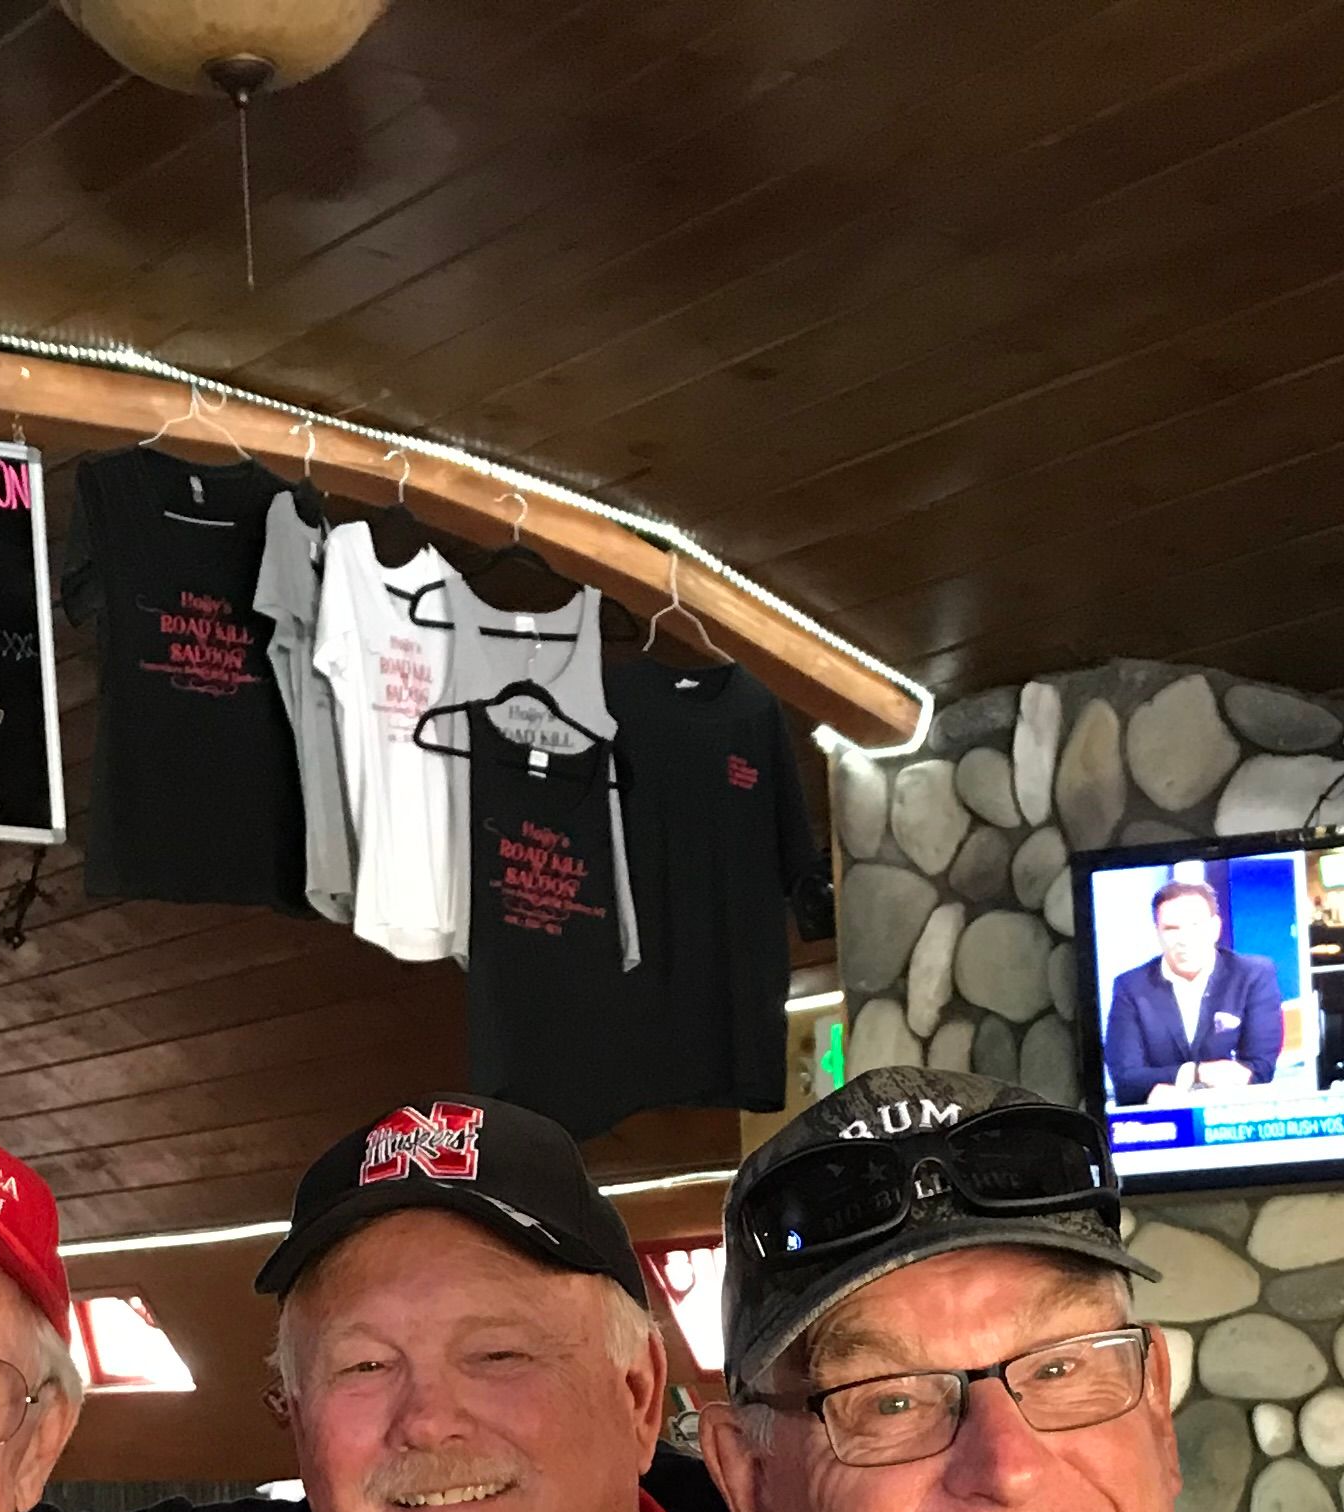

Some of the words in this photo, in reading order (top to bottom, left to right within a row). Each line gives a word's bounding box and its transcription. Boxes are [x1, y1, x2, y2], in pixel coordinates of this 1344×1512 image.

[161, 615, 211, 635] ROAD
[839, 1098, 964, 1140] RUM
[1286, 1118, 1318, 1137] RUSH
